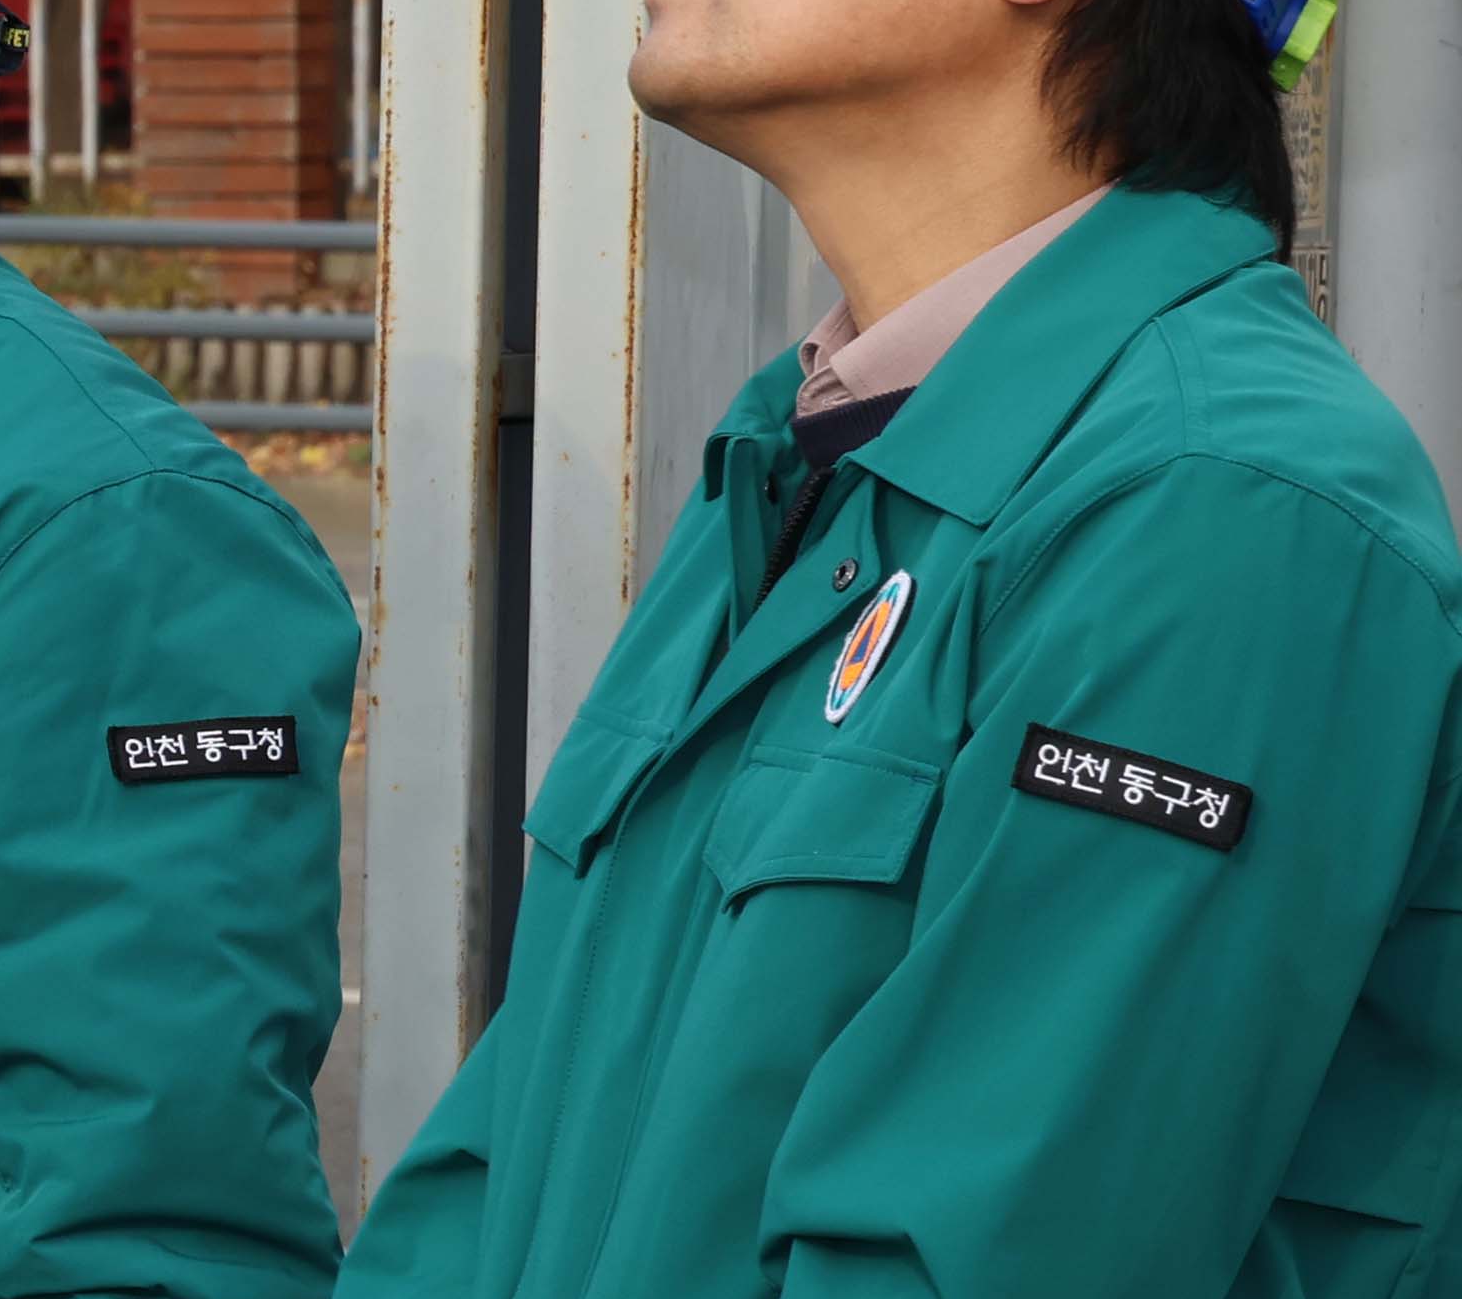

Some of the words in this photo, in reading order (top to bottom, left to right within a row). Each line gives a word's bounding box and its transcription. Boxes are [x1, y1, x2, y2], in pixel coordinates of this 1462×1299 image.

[125, 734, 189, 769] 인천
[196, 728, 283, 763] 동구청
[1034, 744, 1111, 794] 인천
[1118, 763, 1230, 829] 동구청
